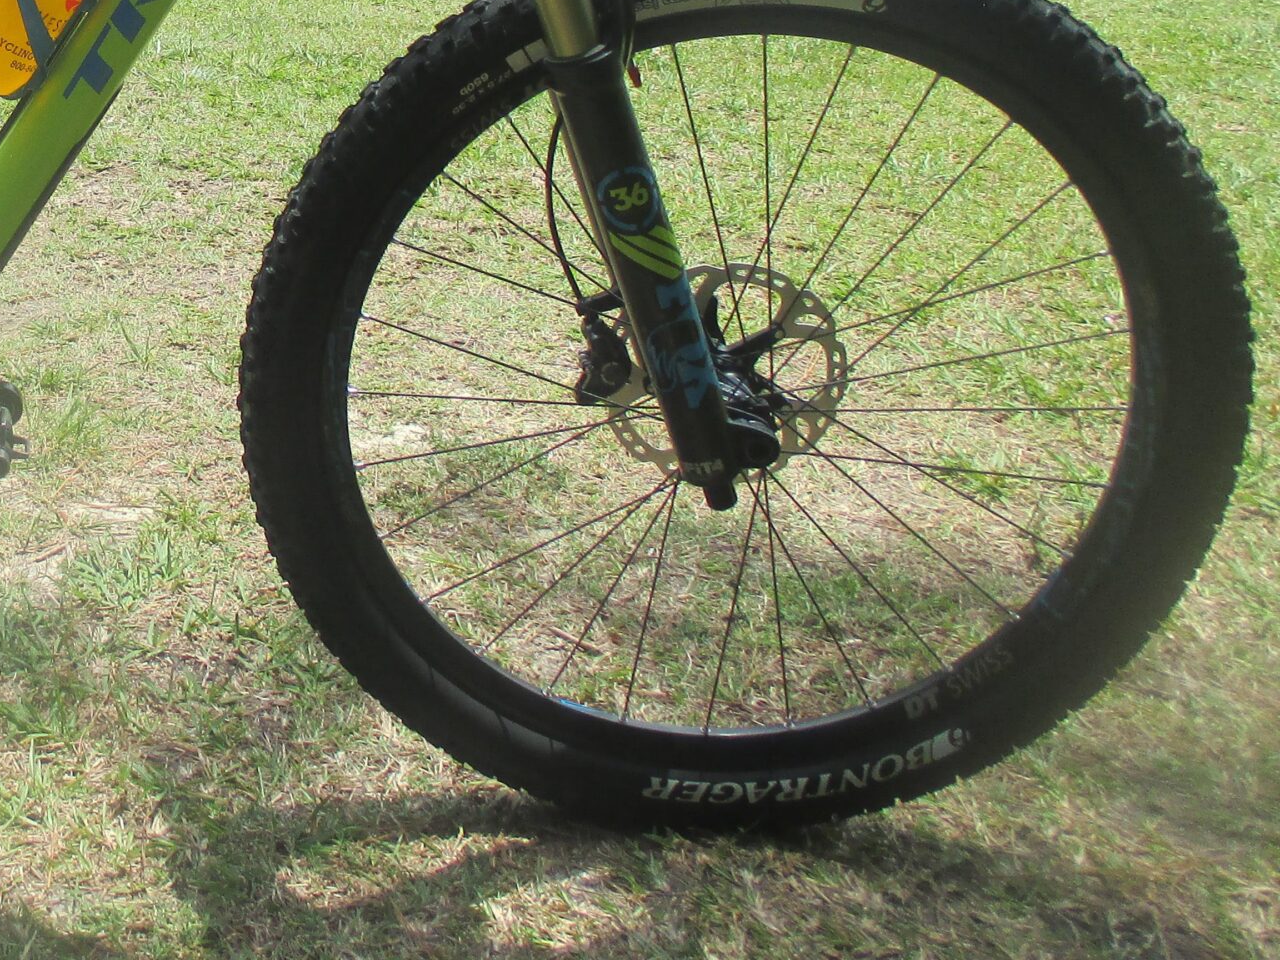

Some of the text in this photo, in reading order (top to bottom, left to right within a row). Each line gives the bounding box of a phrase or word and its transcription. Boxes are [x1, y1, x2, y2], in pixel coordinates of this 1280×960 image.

[608, 181, 649, 211] 36
[946, 645, 1014, 699] SWISS
[641, 738, 937, 805] BONTRAGER
